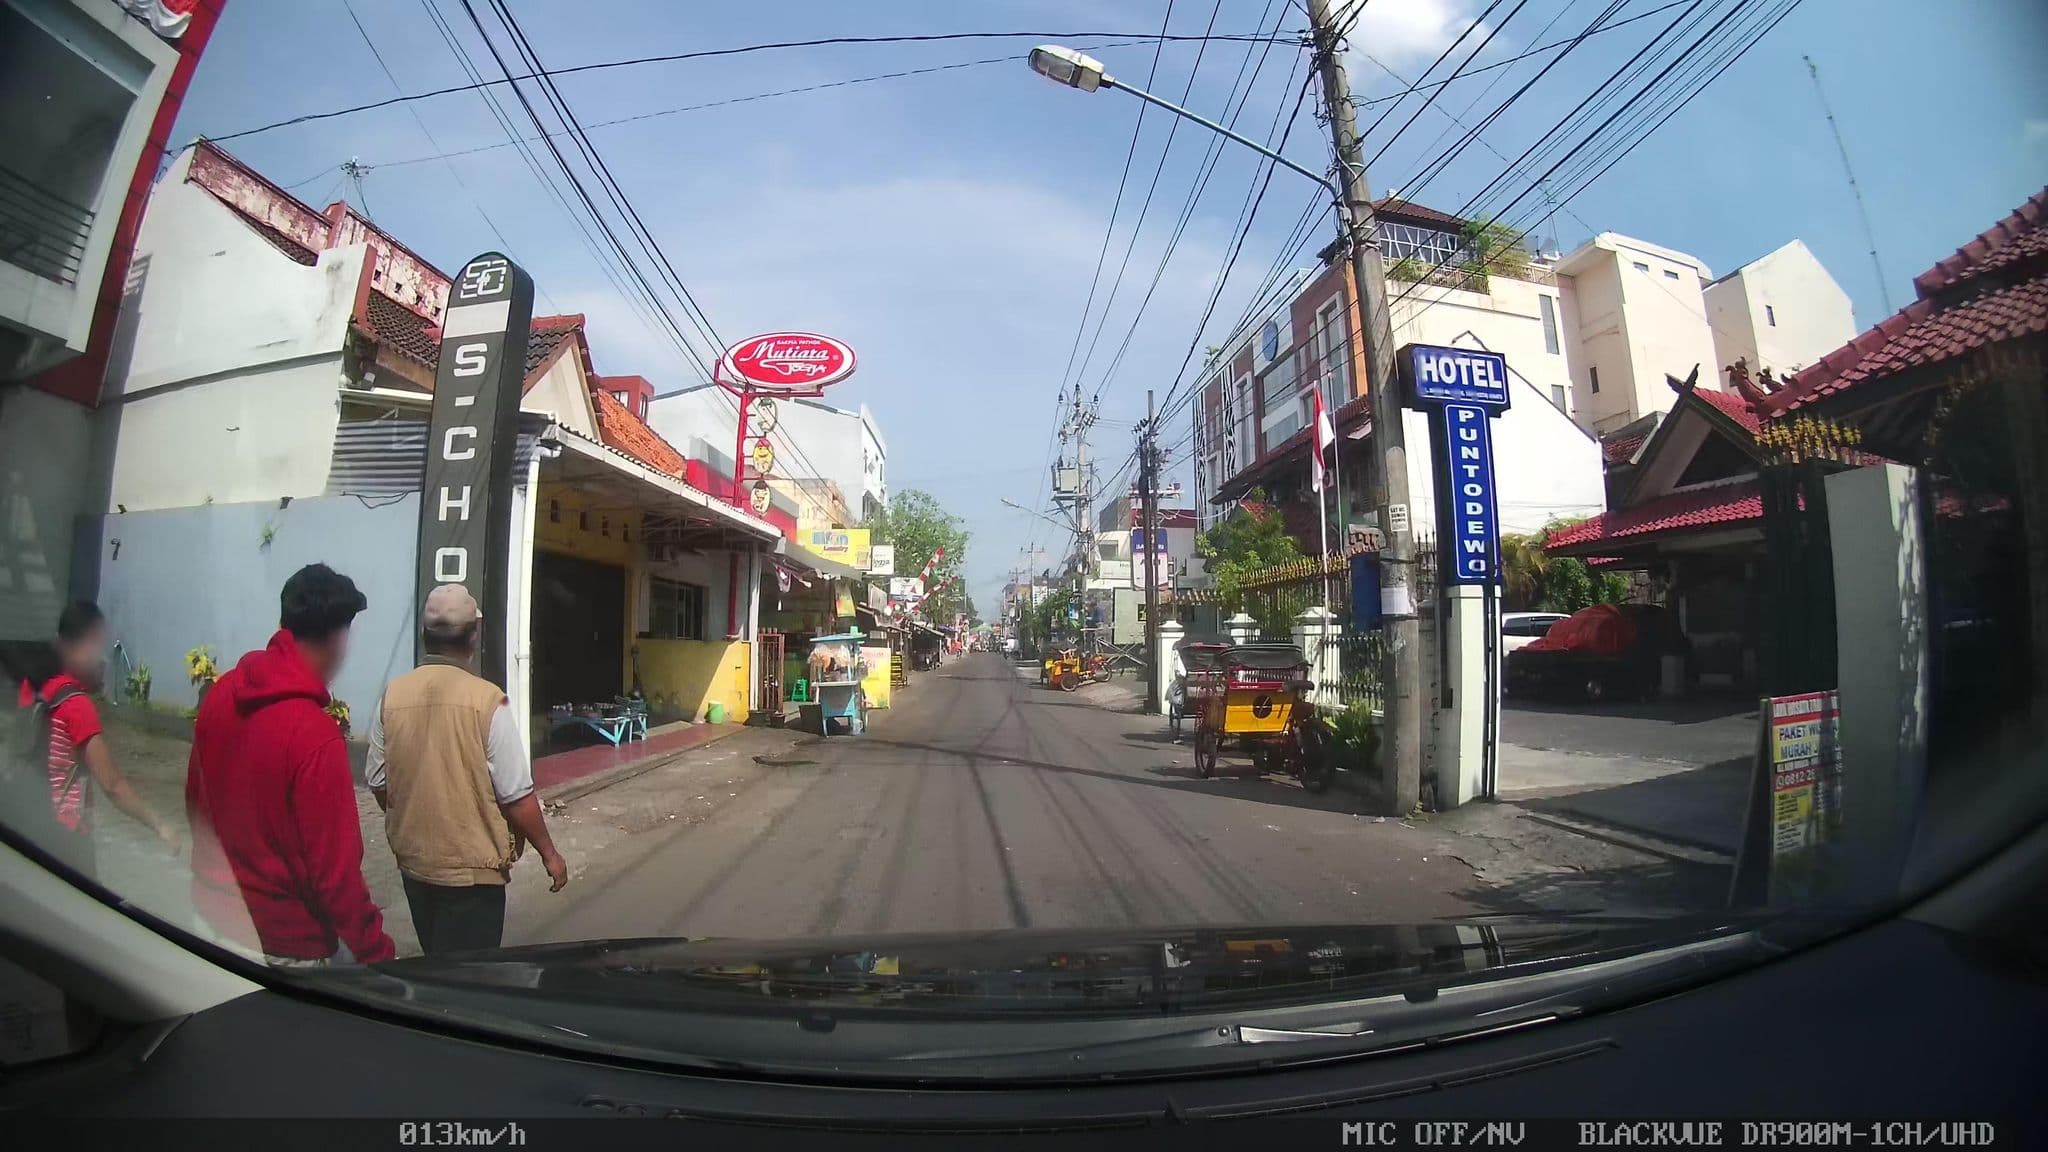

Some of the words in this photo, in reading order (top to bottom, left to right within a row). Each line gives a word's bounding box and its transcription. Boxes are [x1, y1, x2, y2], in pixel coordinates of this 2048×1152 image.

[739, 341, 829, 361] Mutiara
[1419, 354, 1503, 389] HOTEL
[435, 343, 488, 582] S-CHO
[1457, 409, 1487, 572] PUNTODEWO
[1779, 724, 1808, 741] PAKET
[1781, 740, 1812, 759] MURAH
